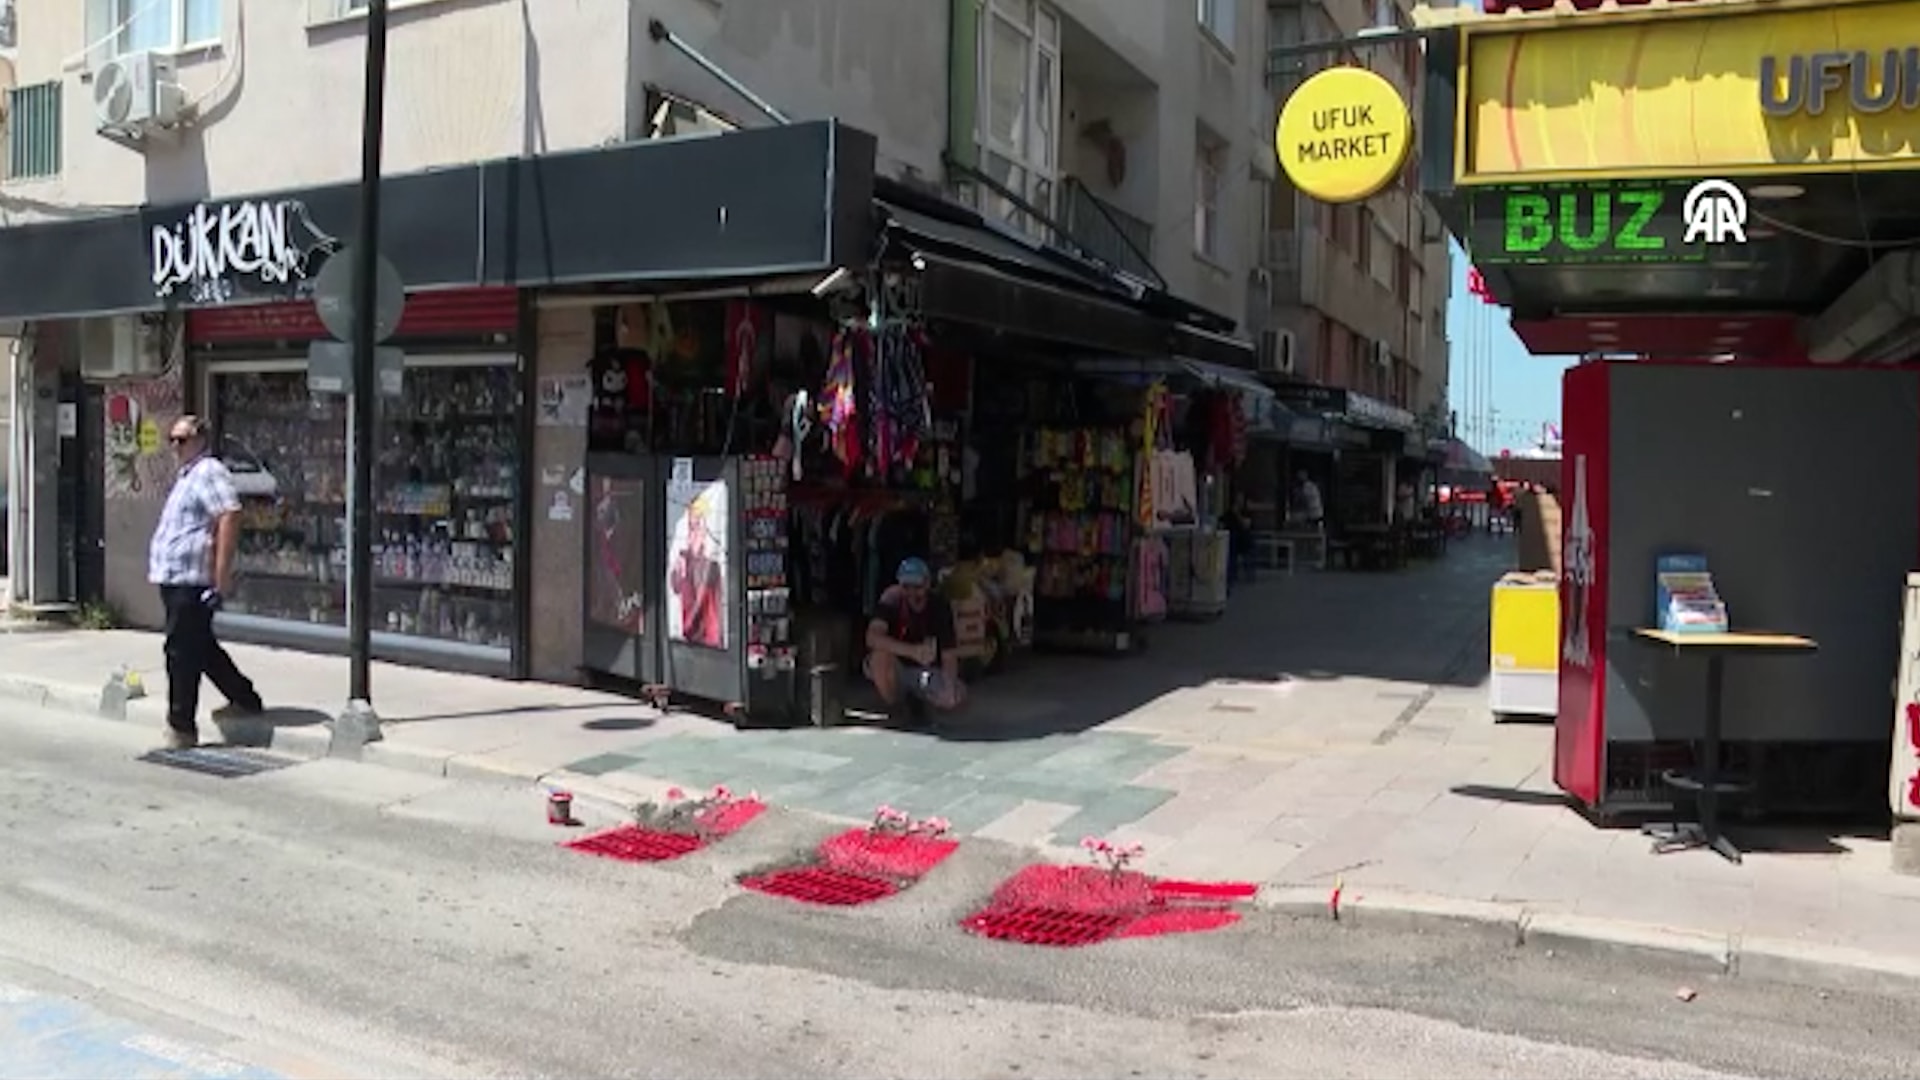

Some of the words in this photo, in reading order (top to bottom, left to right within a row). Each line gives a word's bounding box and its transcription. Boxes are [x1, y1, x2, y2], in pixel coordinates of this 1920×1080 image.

[1312, 105, 1374, 132] UFUK
[1298, 132, 1391, 163] MARKET
[151, 201, 295, 287] DÜKKAN
[1505, 191, 1666, 252] BUZ
